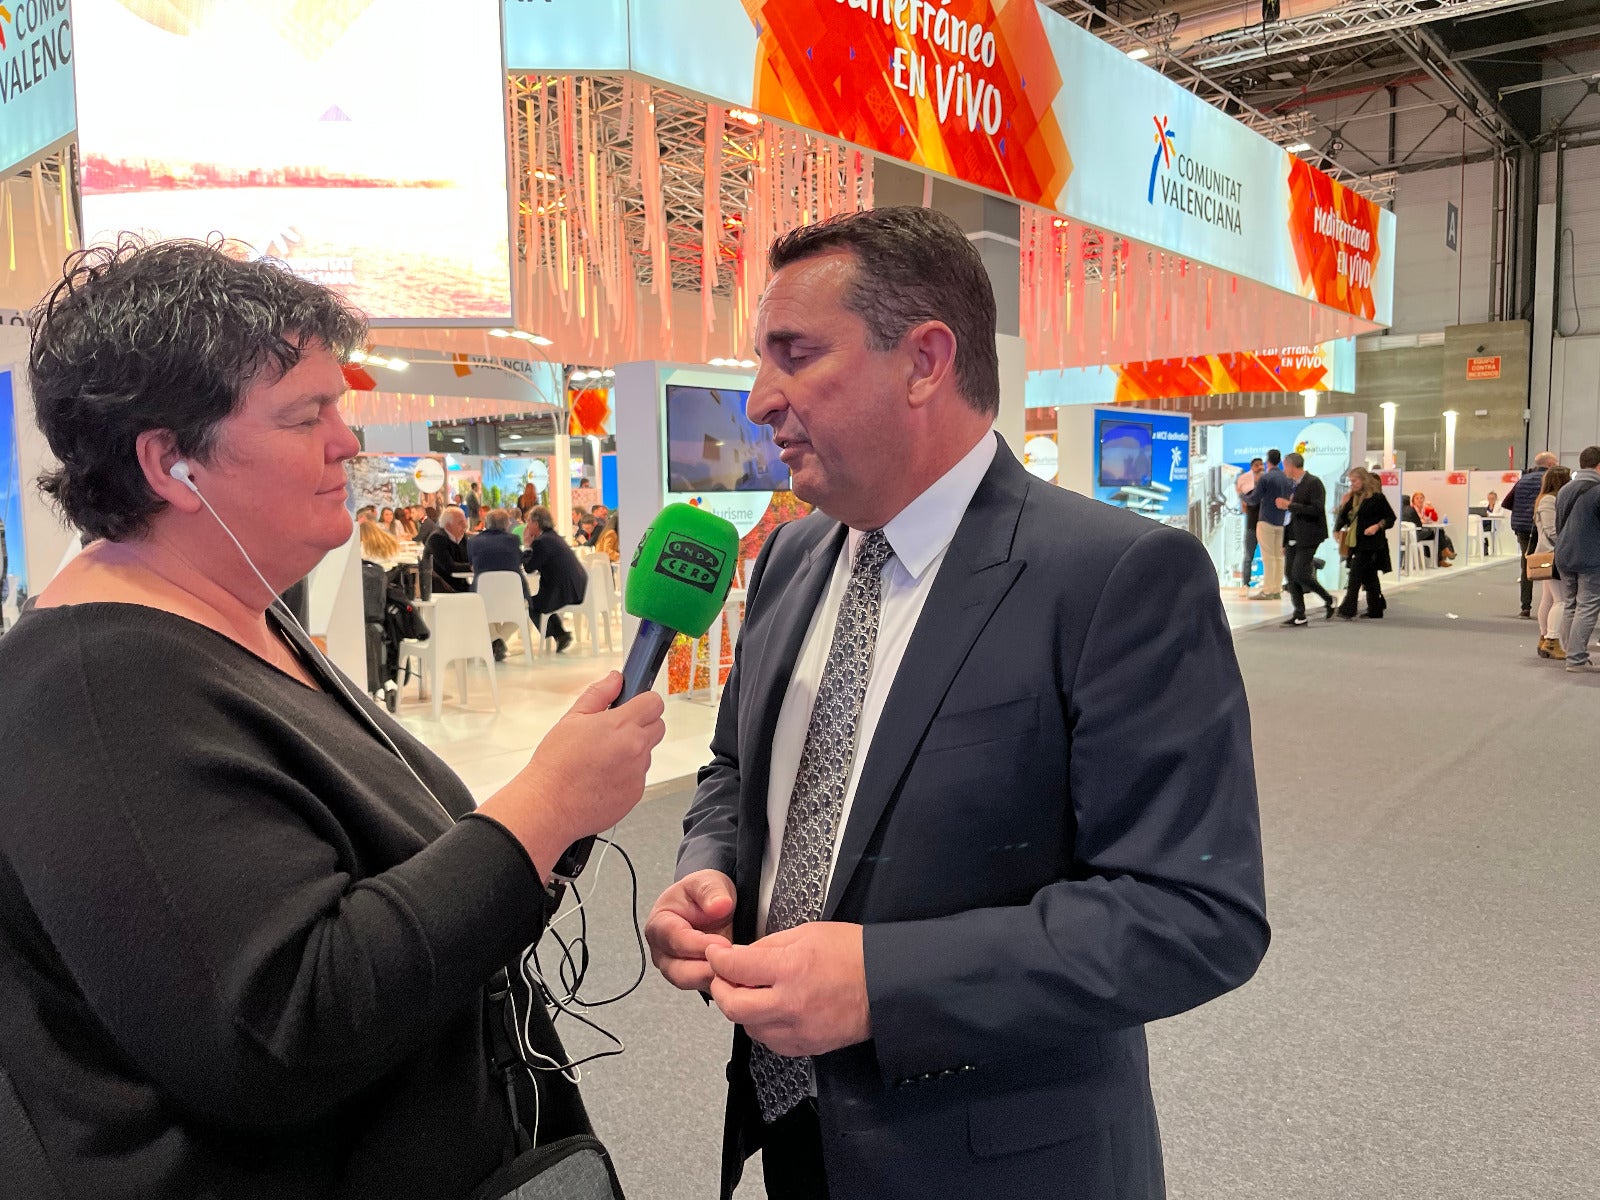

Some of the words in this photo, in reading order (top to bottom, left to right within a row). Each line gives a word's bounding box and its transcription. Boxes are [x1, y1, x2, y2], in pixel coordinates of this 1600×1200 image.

[892, 47, 926, 99] EN
[1178, 154, 1243, 204] COMUNITAT
[1161, 174, 1242, 236] VALENCIANA
[1313, 206, 1371, 252] Mediterráneo
[1448, 211, 1456, 245] A
[1337, 250, 1348, 276] EN
[1281, 356, 1293, 368] EN
[668, 559, 711, 582] CERO
[673, 542, 715, 566] ONDA
